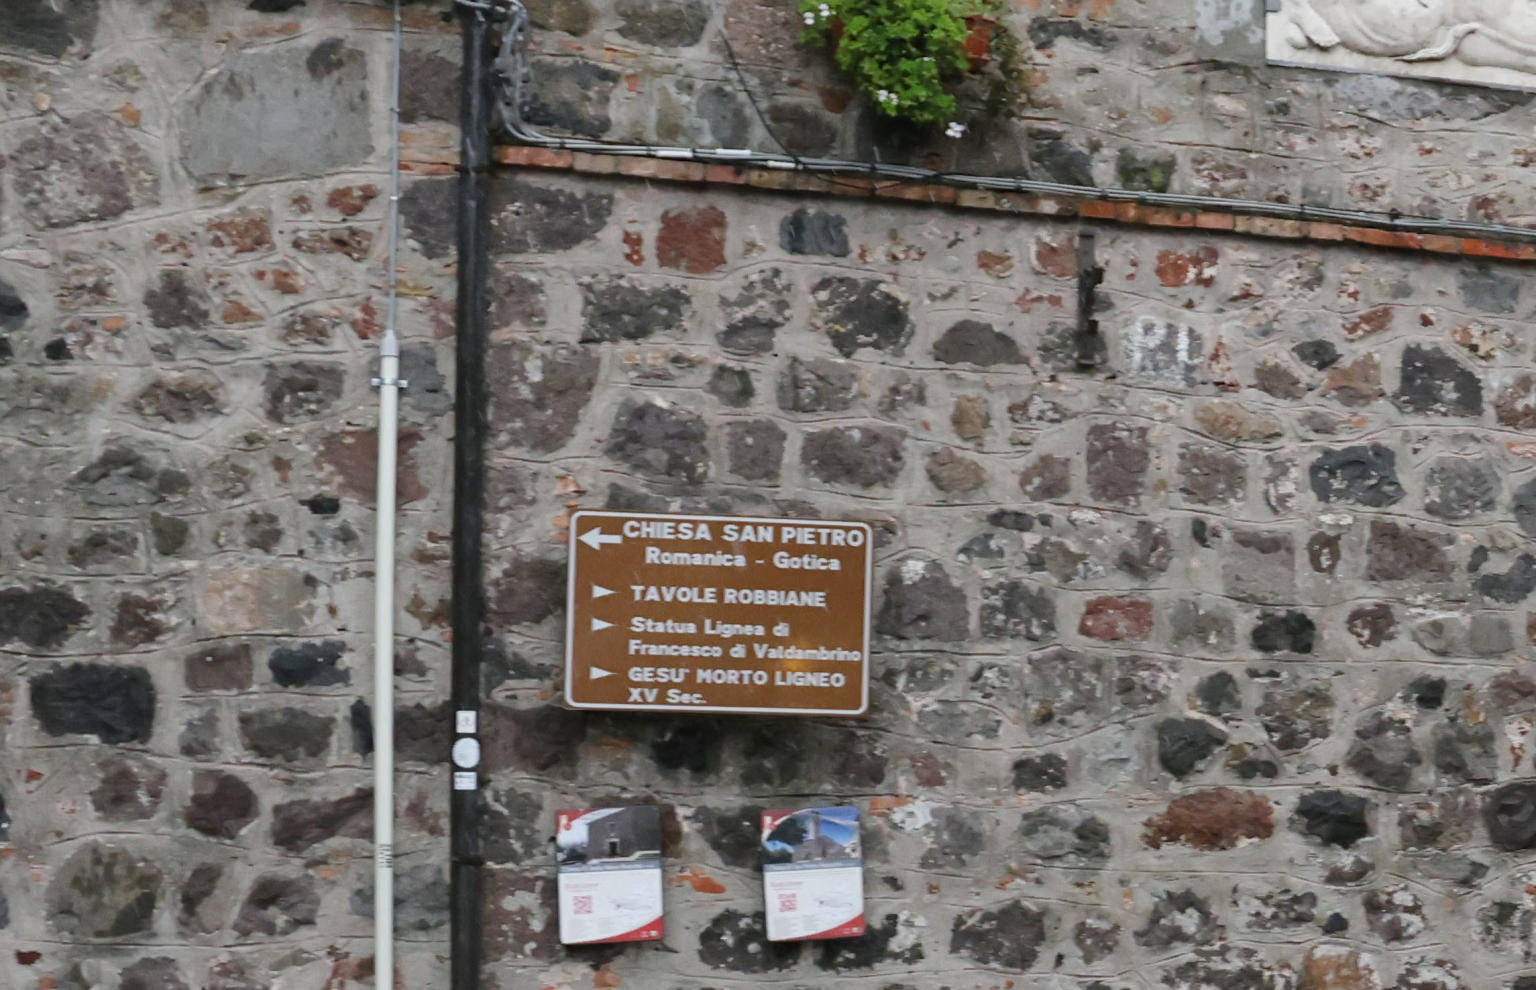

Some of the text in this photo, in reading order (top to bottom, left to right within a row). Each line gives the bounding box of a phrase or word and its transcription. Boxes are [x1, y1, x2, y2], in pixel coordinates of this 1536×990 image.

[622, 520, 865, 547] CHIESA SAN PIETRO
[645, 546, 747, 567] Romanica
[772, 551, 841, 571] Gotica
[630, 585, 827, 607] TAVOLE ROBBIANE
[630, 616, 790, 638] Statua Lignea di
[628, 639, 862, 661] Francesco di Valdambrino
[696, 668, 769, 686] MORTO
[774, 671, 846, 688] LIGNEO
[626, 687, 707, 704] XV Sec.
